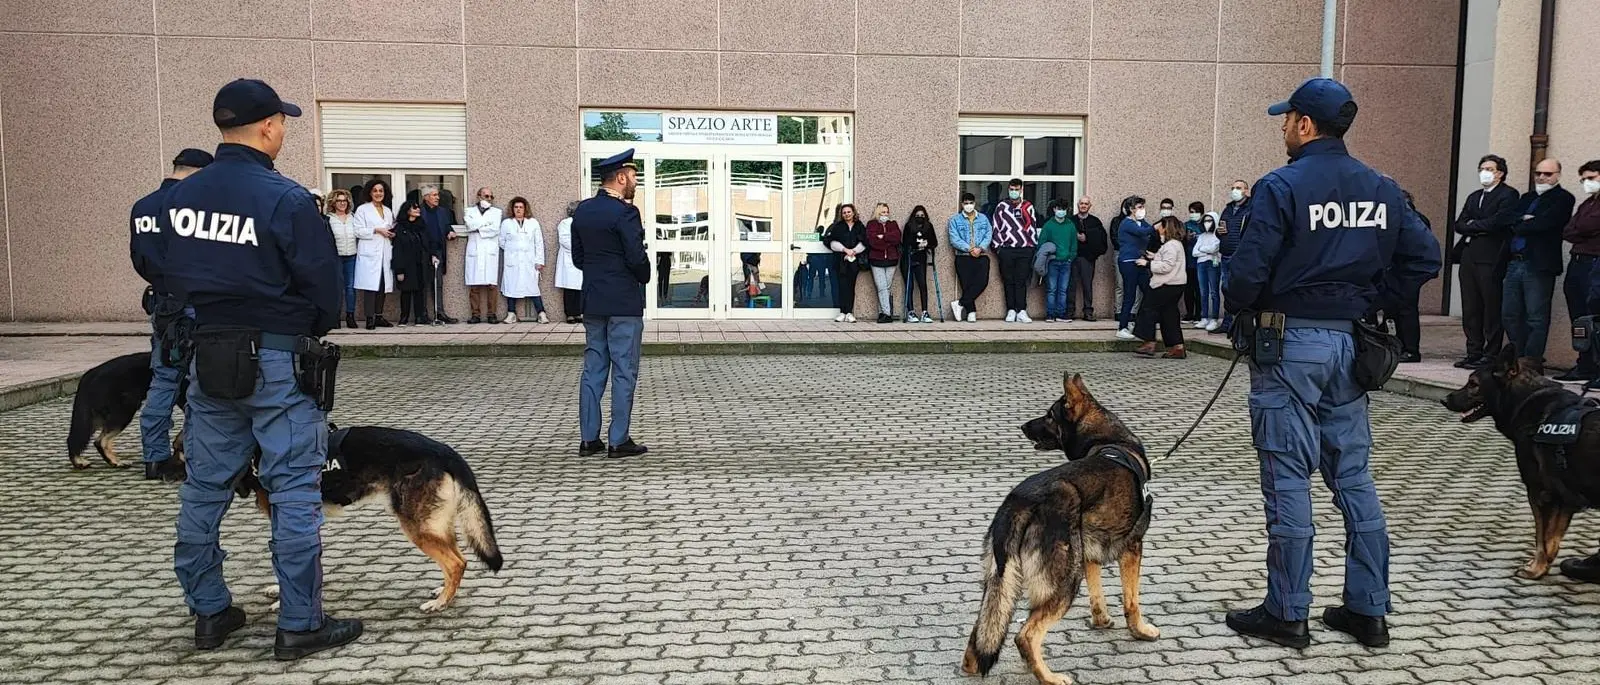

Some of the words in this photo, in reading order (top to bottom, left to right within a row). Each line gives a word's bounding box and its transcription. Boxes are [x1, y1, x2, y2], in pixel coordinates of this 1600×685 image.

[668, 116, 726, 131] SPAZIO
[730, 117, 772, 131] ARTE
[1537, 423, 1577, 435] POLIZIA
